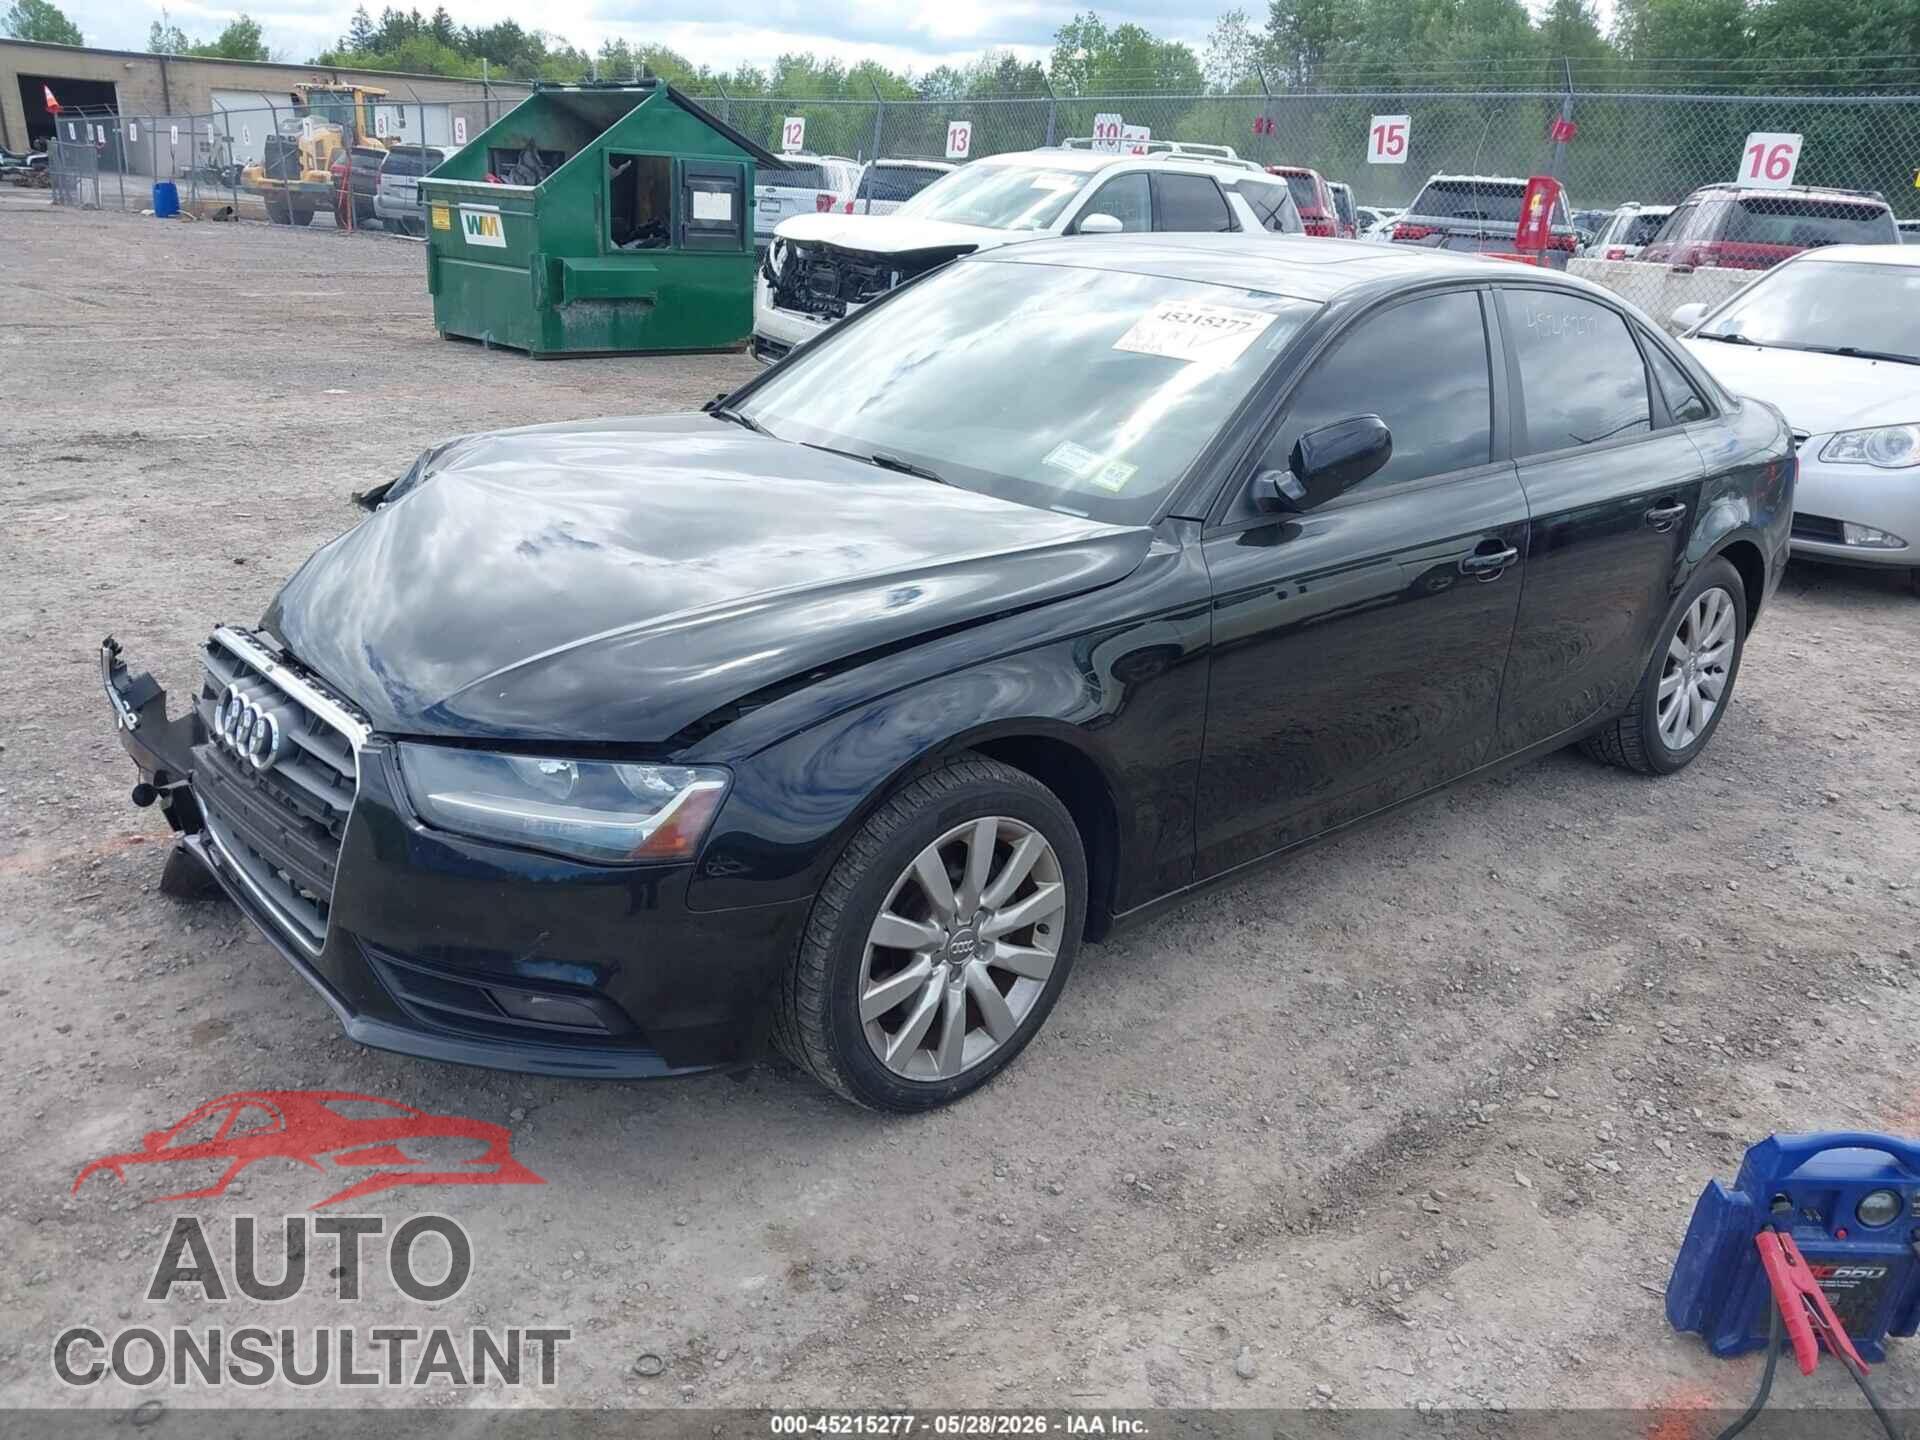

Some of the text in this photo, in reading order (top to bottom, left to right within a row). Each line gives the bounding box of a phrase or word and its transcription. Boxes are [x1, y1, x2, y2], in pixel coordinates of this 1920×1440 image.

[784, 122, 803, 145] 12
[949, 127, 969, 152] 13
[1096, 122, 1119, 147] 10
[1372, 124, 1406, 156] 15
[1747, 142, 1795, 181] 16
[464, 213, 501, 237] WM
[1158, 310, 1253, 332] 45215277
